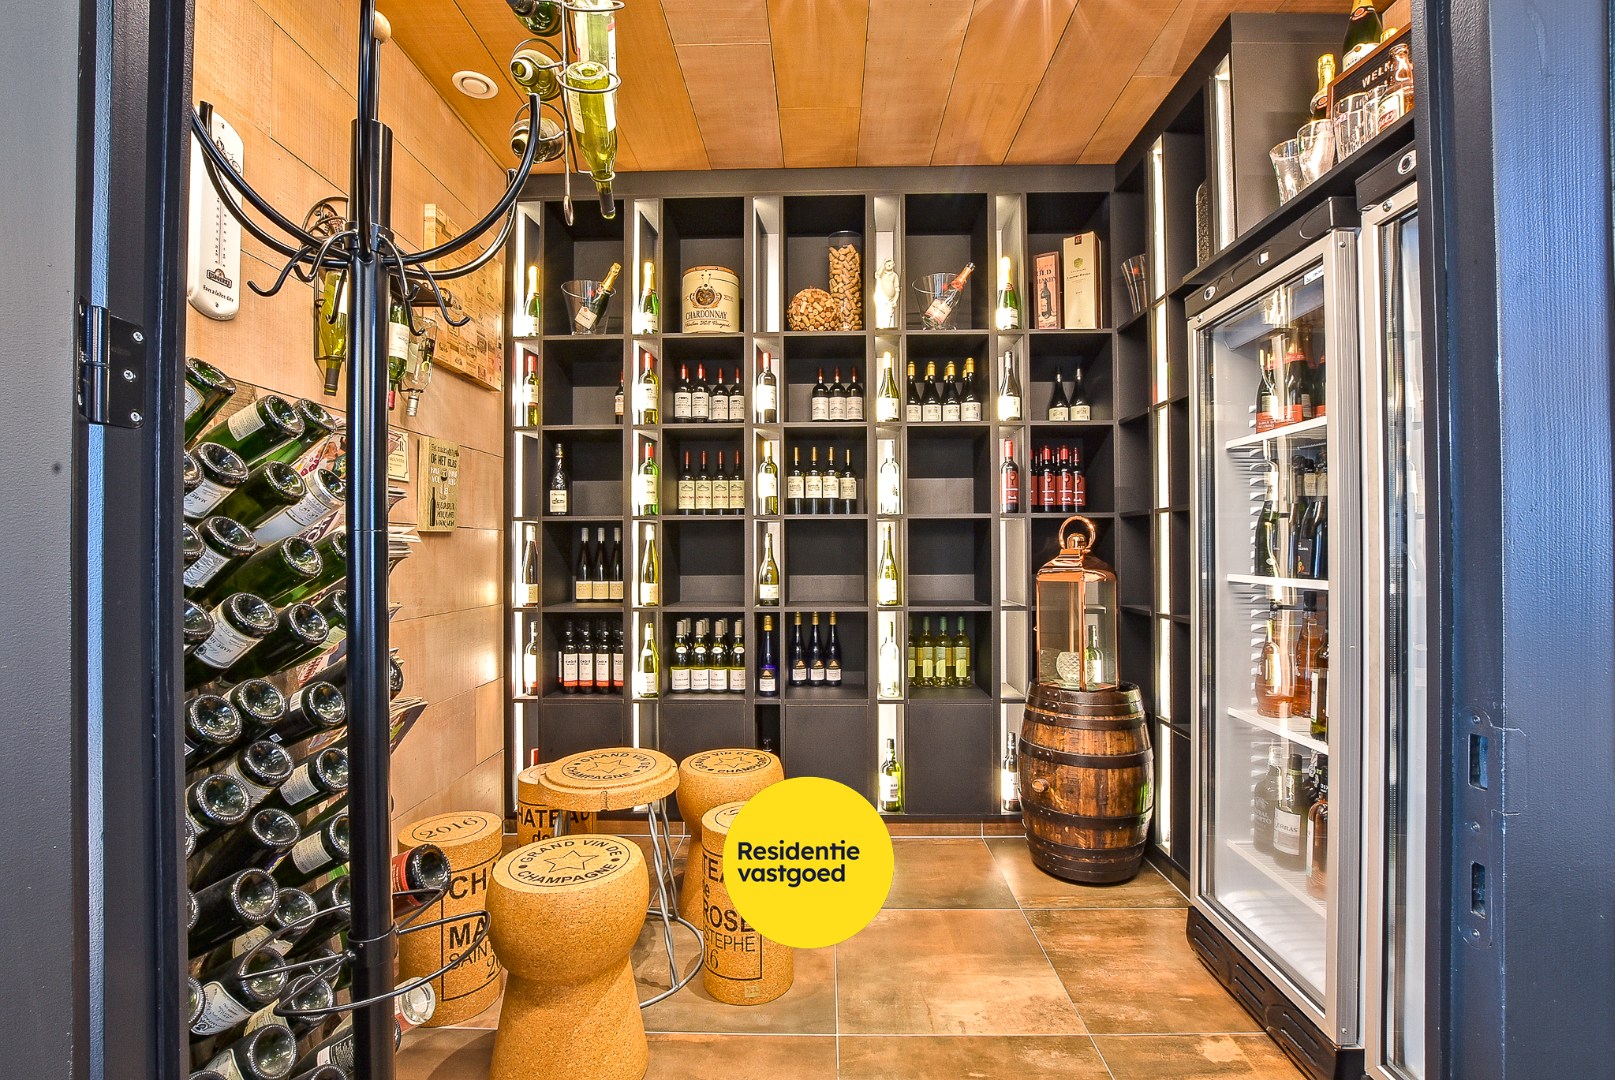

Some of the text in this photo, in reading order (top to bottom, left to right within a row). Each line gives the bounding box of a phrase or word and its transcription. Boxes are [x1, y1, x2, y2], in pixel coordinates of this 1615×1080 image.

[686, 310, 727, 320] CHARDONNAY
[420, 817, 478, 840] 2016
[520, 839, 623, 863] GRAND VIN DE
[449, 862, 497, 900] CH
[517, 862, 618, 884] CHAMPAGNE
